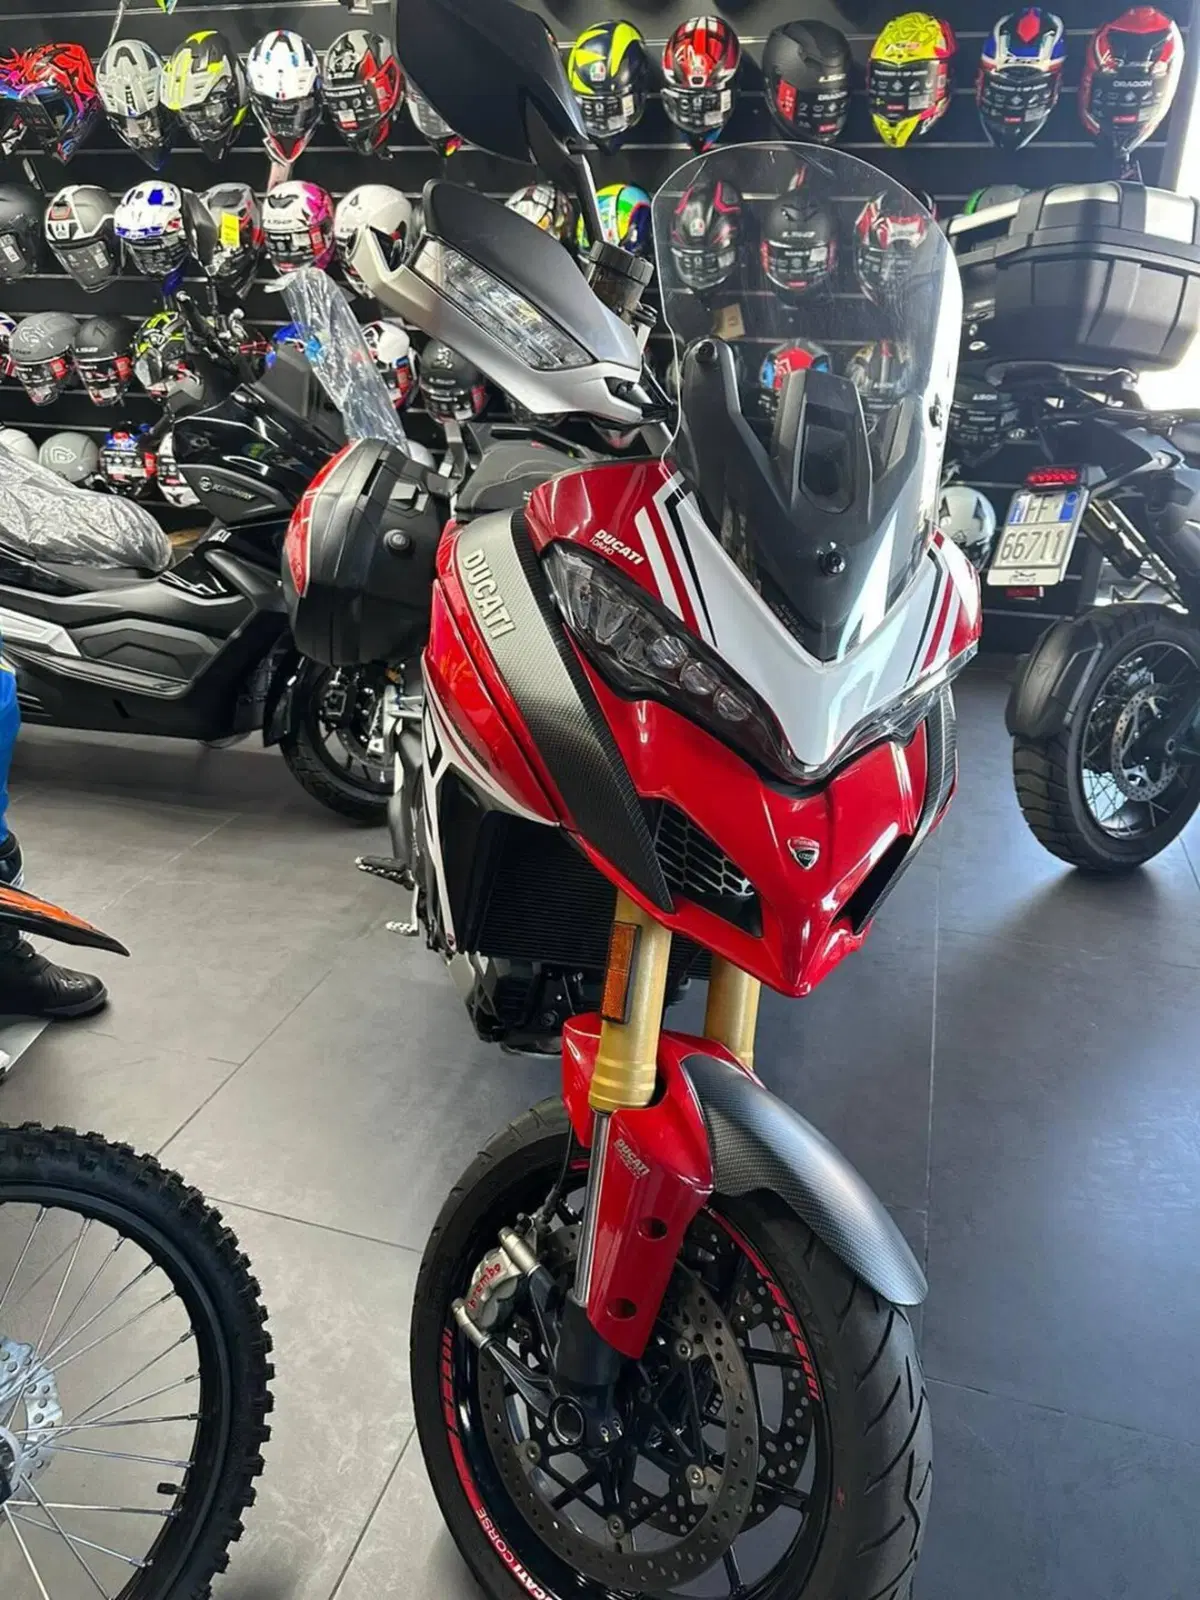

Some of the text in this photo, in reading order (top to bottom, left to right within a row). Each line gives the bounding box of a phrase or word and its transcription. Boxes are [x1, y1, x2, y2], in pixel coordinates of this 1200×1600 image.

[1112, 80, 1153, 88] DRAGON
[593, 529, 645, 565] DUCATI
[1001, 530, 1066, 561] 66711
[463, 548, 517, 639] DUCATI
[615, 1138, 650, 1177] DUCATI
[475, 1506, 515, 1563] CORSE
